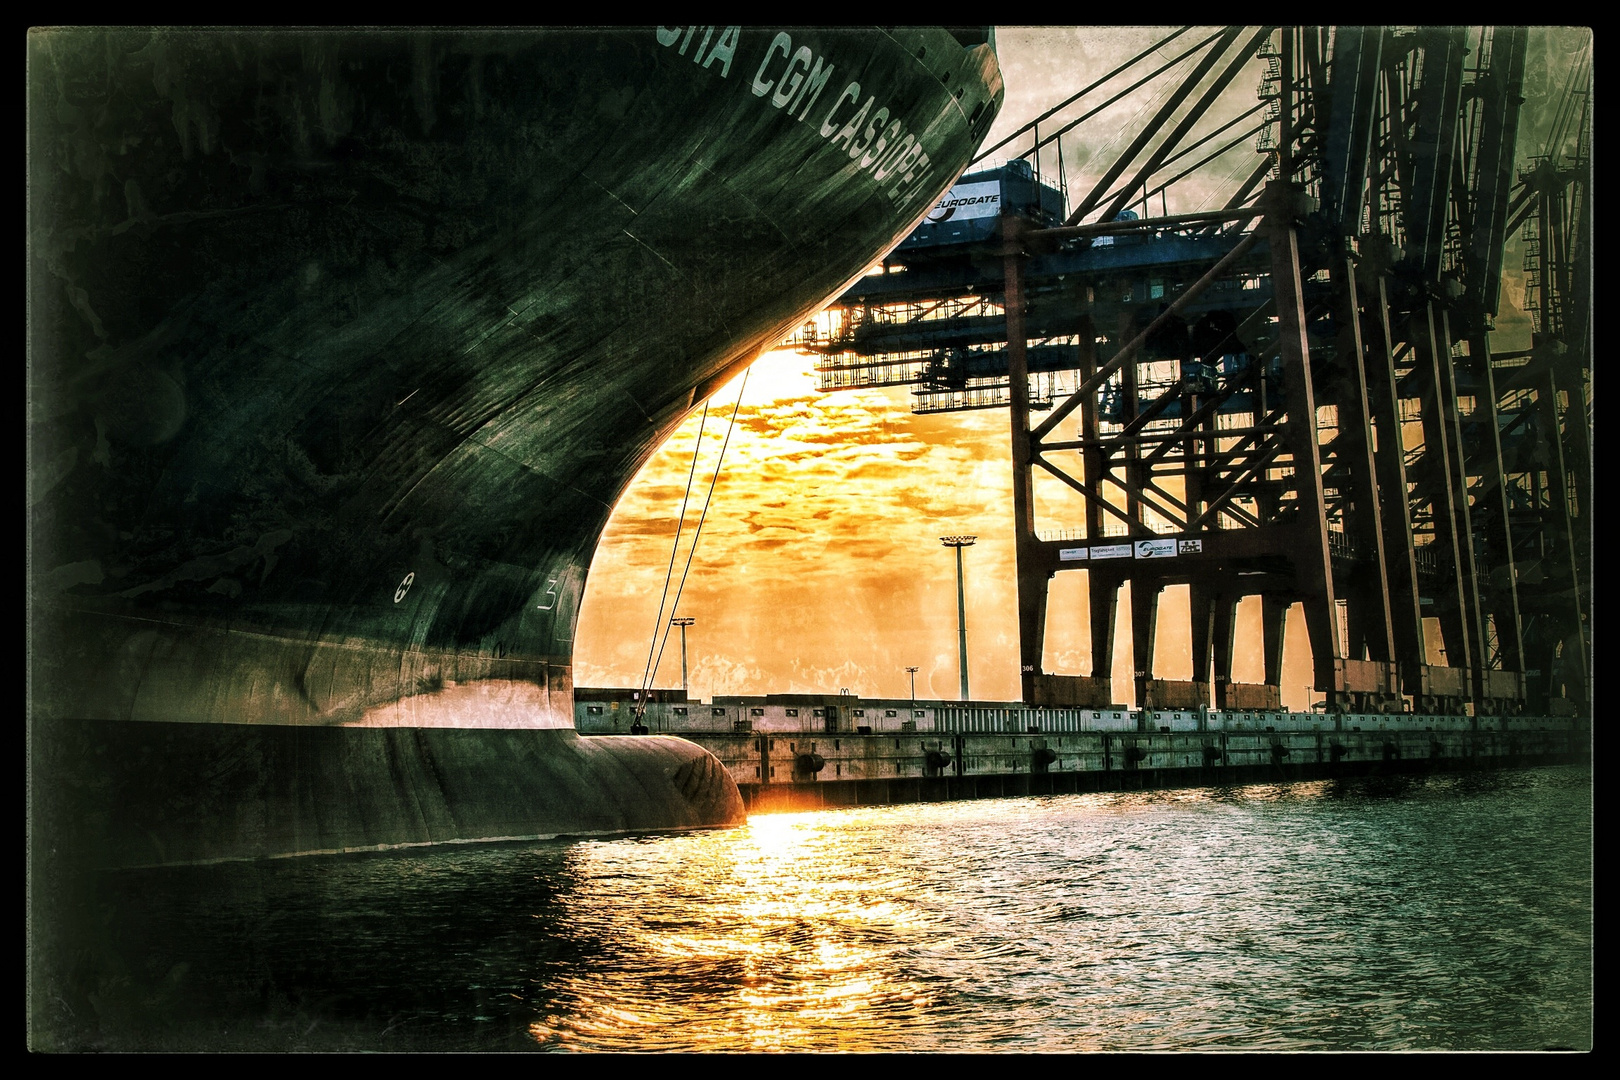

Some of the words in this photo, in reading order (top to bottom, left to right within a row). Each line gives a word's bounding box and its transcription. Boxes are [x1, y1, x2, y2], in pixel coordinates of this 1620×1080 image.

[751, 31, 835, 122] CGM
[934, 193, 1000, 209] EUROGATE
[1022, 664, 1034, 672] 306
